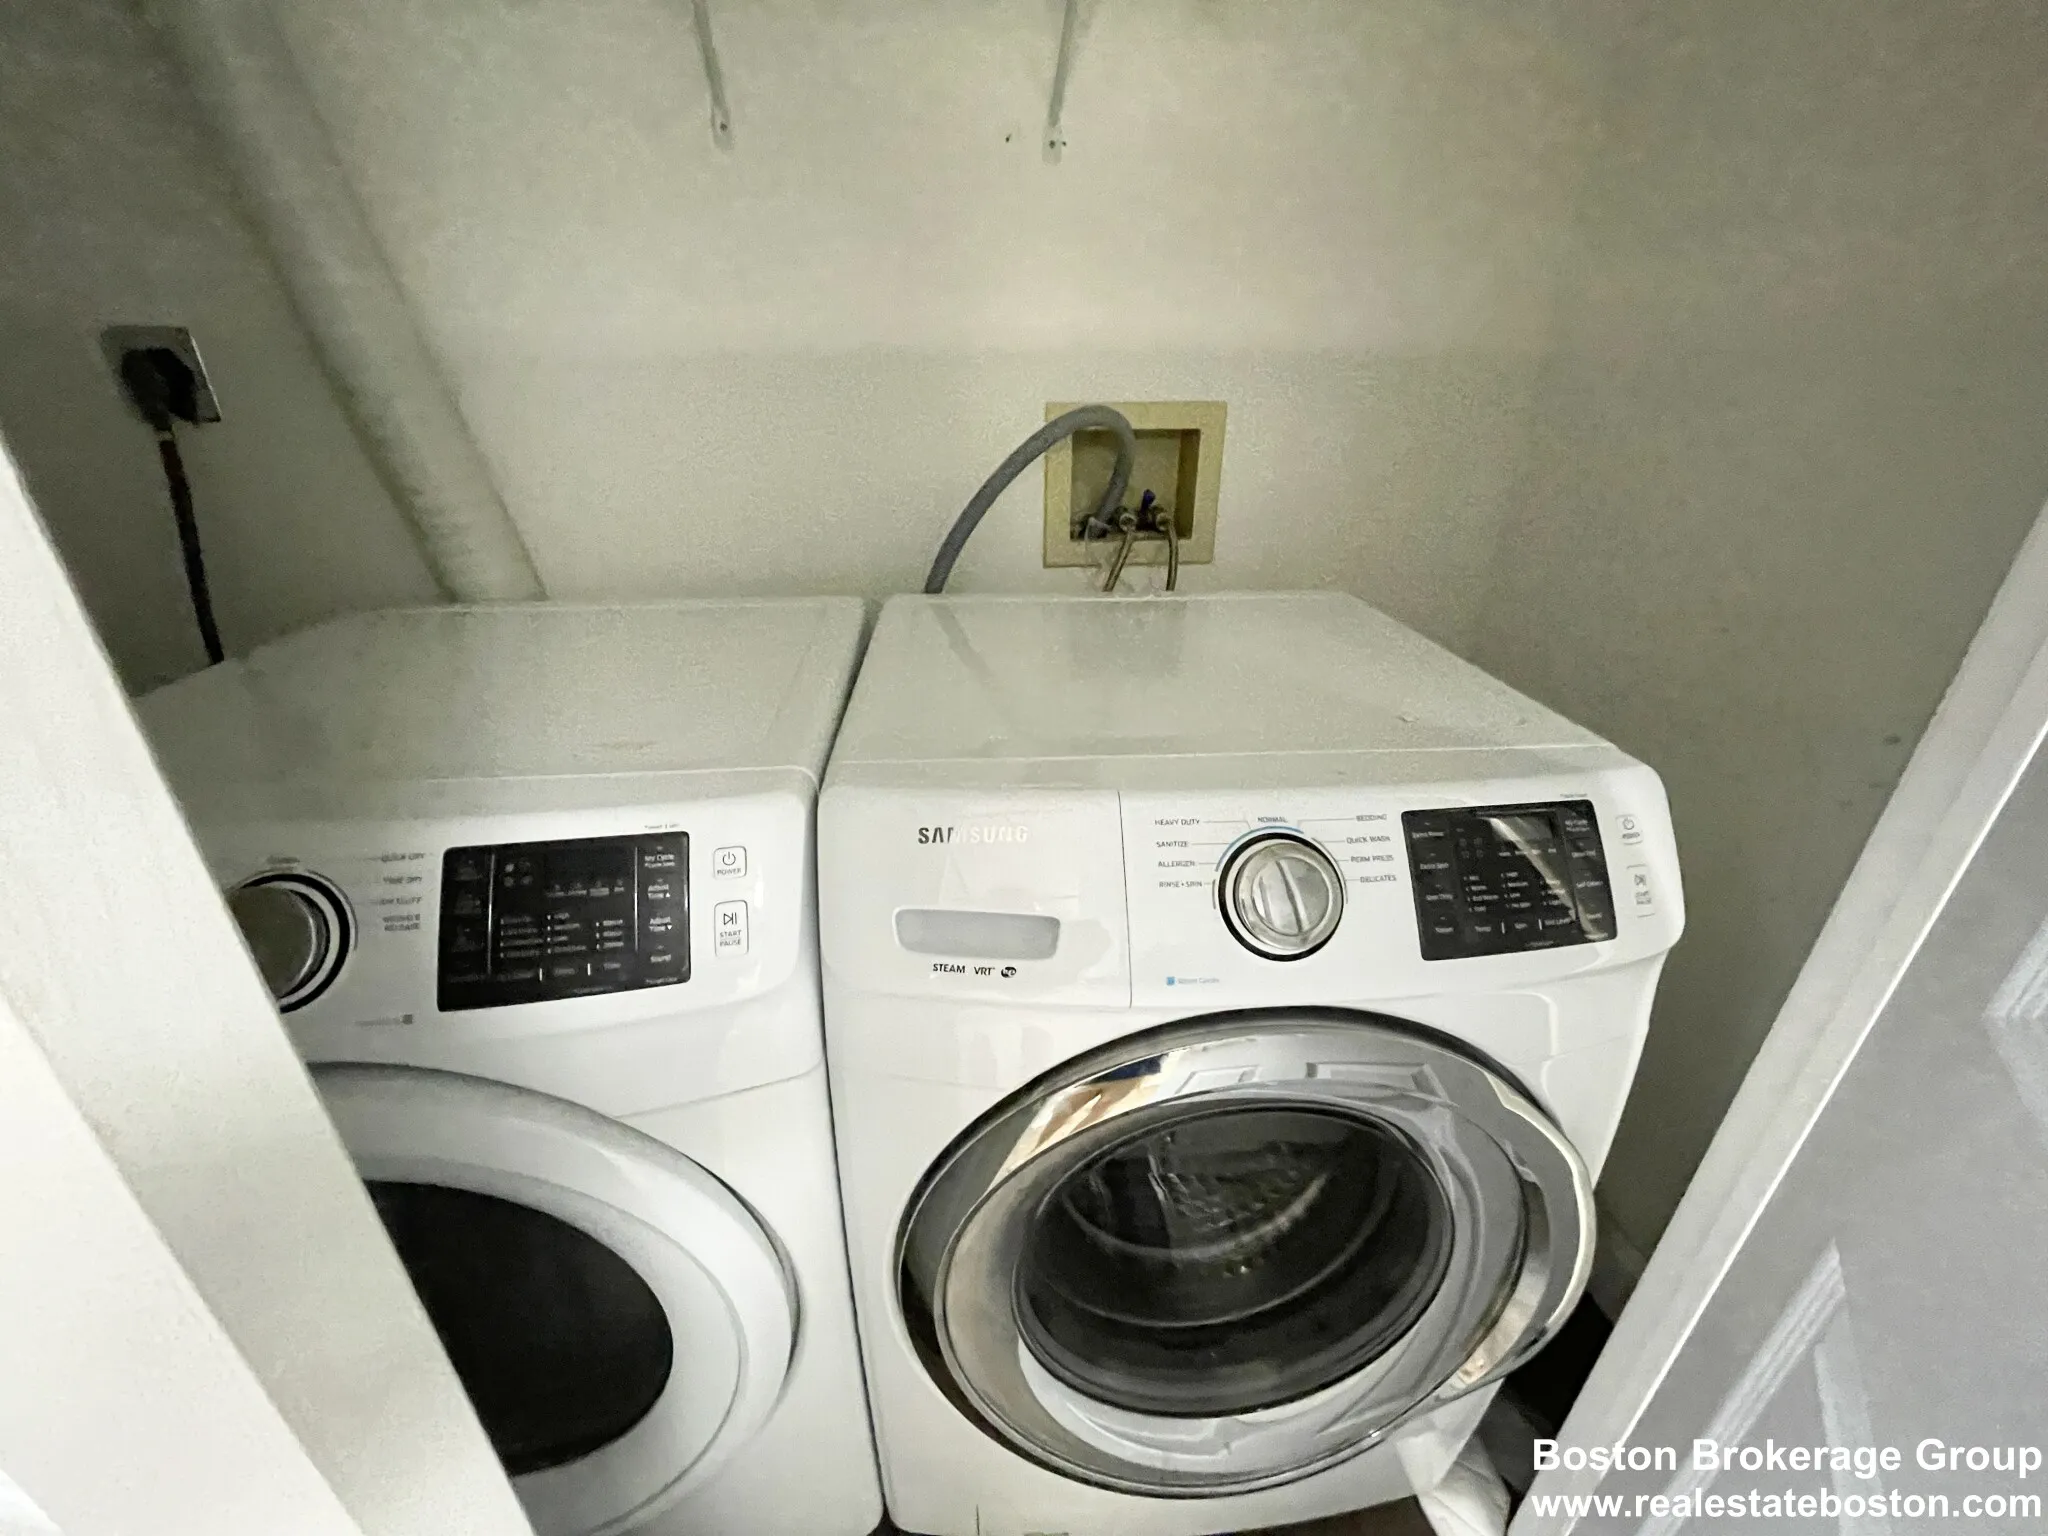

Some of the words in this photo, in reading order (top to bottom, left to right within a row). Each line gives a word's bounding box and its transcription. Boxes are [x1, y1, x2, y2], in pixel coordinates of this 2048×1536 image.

[1154, 818, 1179, 826] HEAVY
[1180, 818, 1200, 826] DUTY
[917, 825, 1028, 845] SAMSUNG
[1156, 840, 1188, 848] SANITIZE
[1346, 836, 1368, 844] QUICK
[717, 867, 742, 876] POWER
[1360, 874, 1397, 883] DELICATES
[720, 929, 742, 938] START
[720, 938, 742, 947] PAUSE
[932, 963, 966, 974] STEAM
